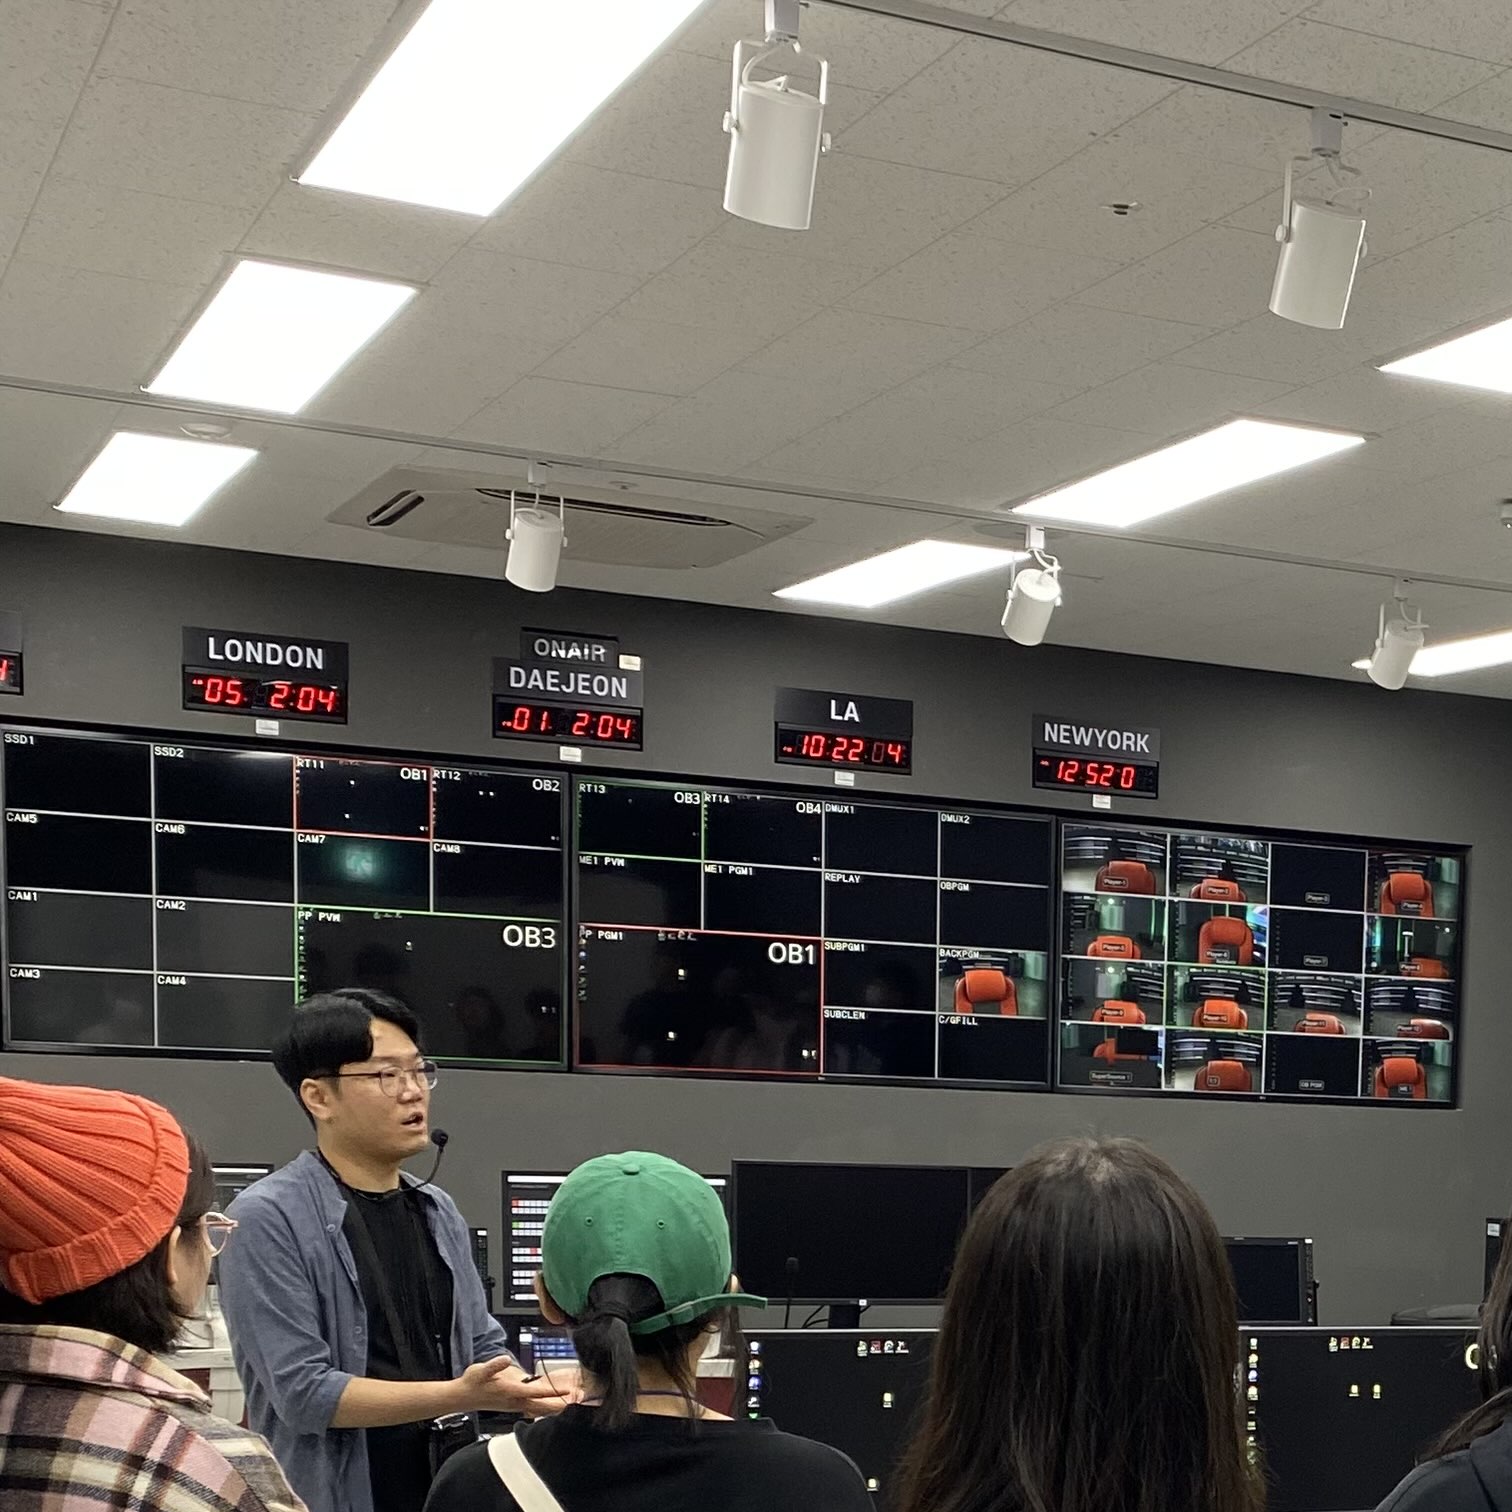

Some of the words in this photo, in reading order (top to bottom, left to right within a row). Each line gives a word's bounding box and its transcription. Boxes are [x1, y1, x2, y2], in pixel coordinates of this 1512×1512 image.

[207, 637, 323, 669] LONDON
[534, 638, 606, 662] ONAIR
[509, 666, 627, 698] DAEJEON
[830, 699, 860, 722] LA
[4, 733, 34, 745] SSD1
[1044, 722, 1149, 753] NEWYORK
[154, 746, 184, 758] SSD2
[297, 757, 325, 770] RT11
[399, 767, 427, 782] OB1
[433, 770, 461, 781] RT12
[532, 778, 560, 793] OB2
[578, 783, 606, 794] RT13
[673, 791, 701, 805] OB3
[705, 793, 730, 804] RT14
[795, 801, 822, 815] OB4
[825, 804, 855, 815] DMUX1
[6, 811, 38, 824] CAM5
[941, 813, 970, 825] DMUX2
[155, 822, 186, 835] CAM6
[297, 833, 326, 845] CAM7
[728, 865, 753, 876] PGM1
[824, 872, 861, 884] REPLAY
[7, 890, 38, 902] CAM1
[156, 899, 186, 911] CAM2
[503, 924, 556, 949] OB3
[597, 931, 623, 943] PGM1
[824, 941, 865, 953] SUBPGM1
[768, 942, 815, 965] OB1
[9, 968, 41, 980] CAM3
[157, 975, 187, 987] CAM4
